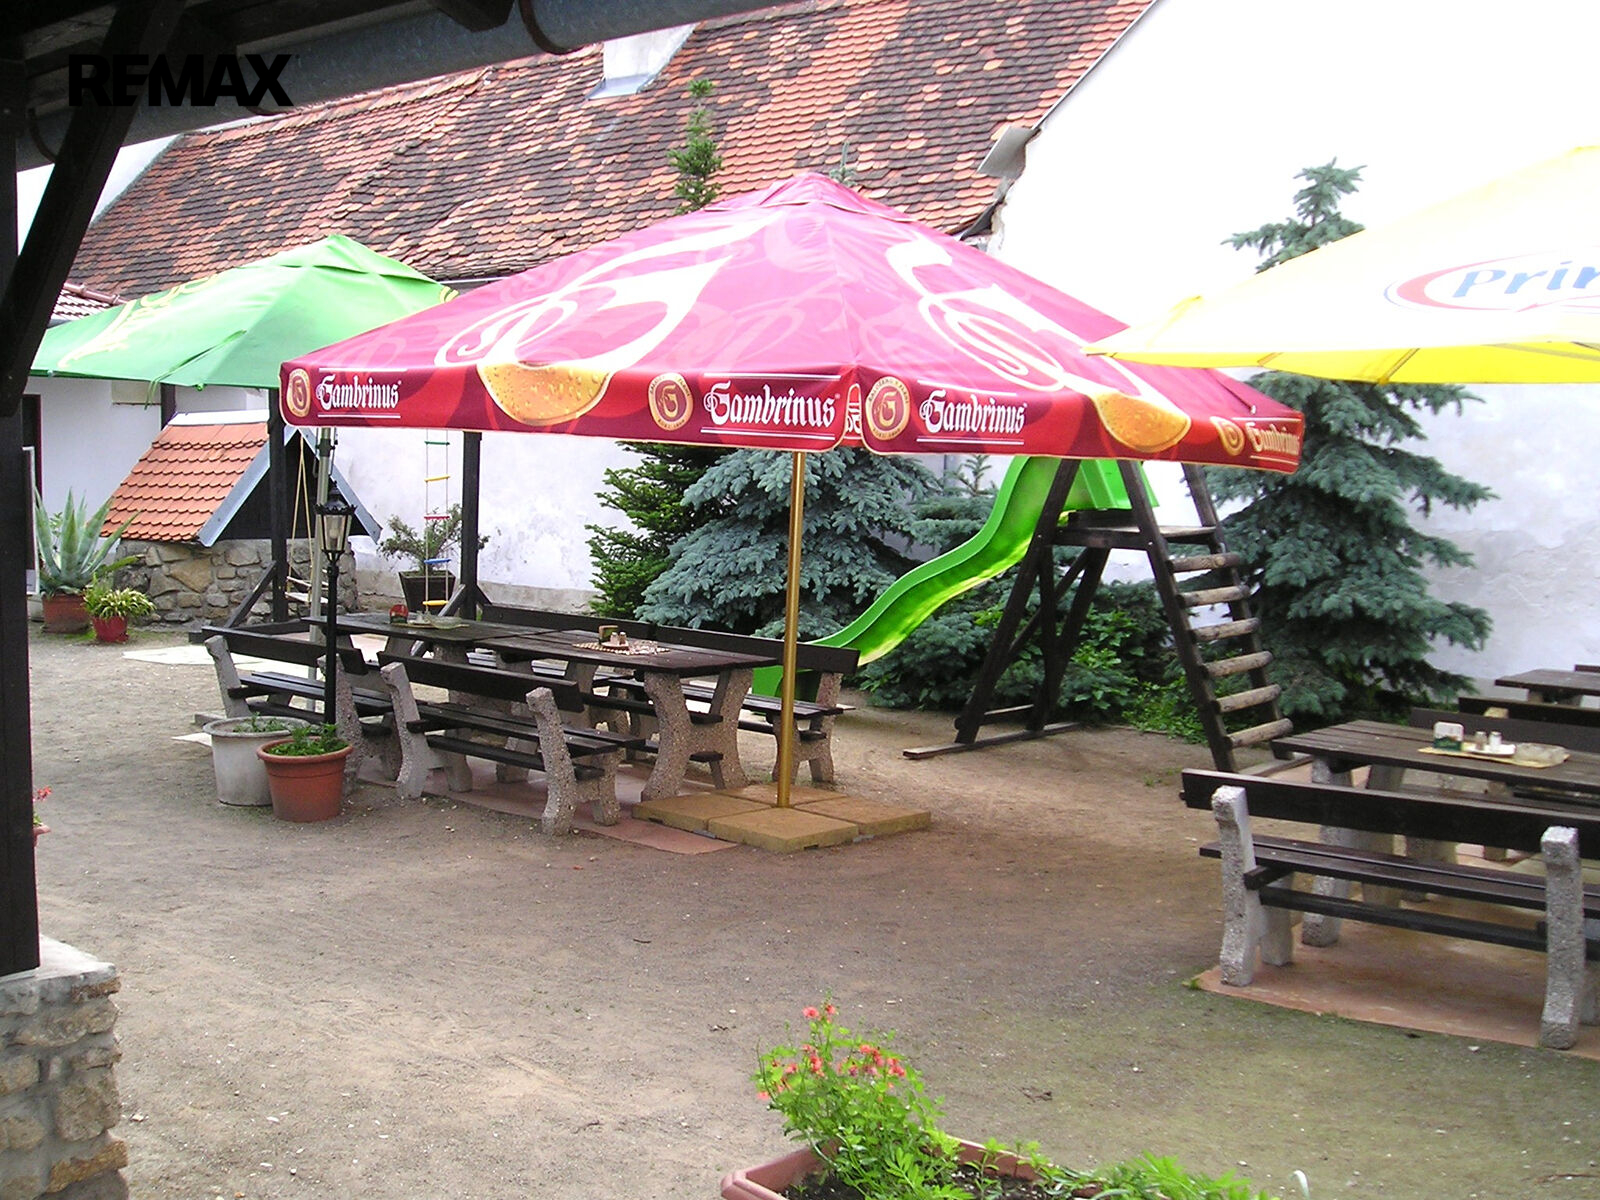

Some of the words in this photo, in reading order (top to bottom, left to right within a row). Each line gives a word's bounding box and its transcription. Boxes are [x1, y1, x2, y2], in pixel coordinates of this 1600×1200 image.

[316, 374, 400, 410] Gambrinus
[705, 380, 836, 428] Gambrinus
[919, 389, 1025, 434] Gambrinus
